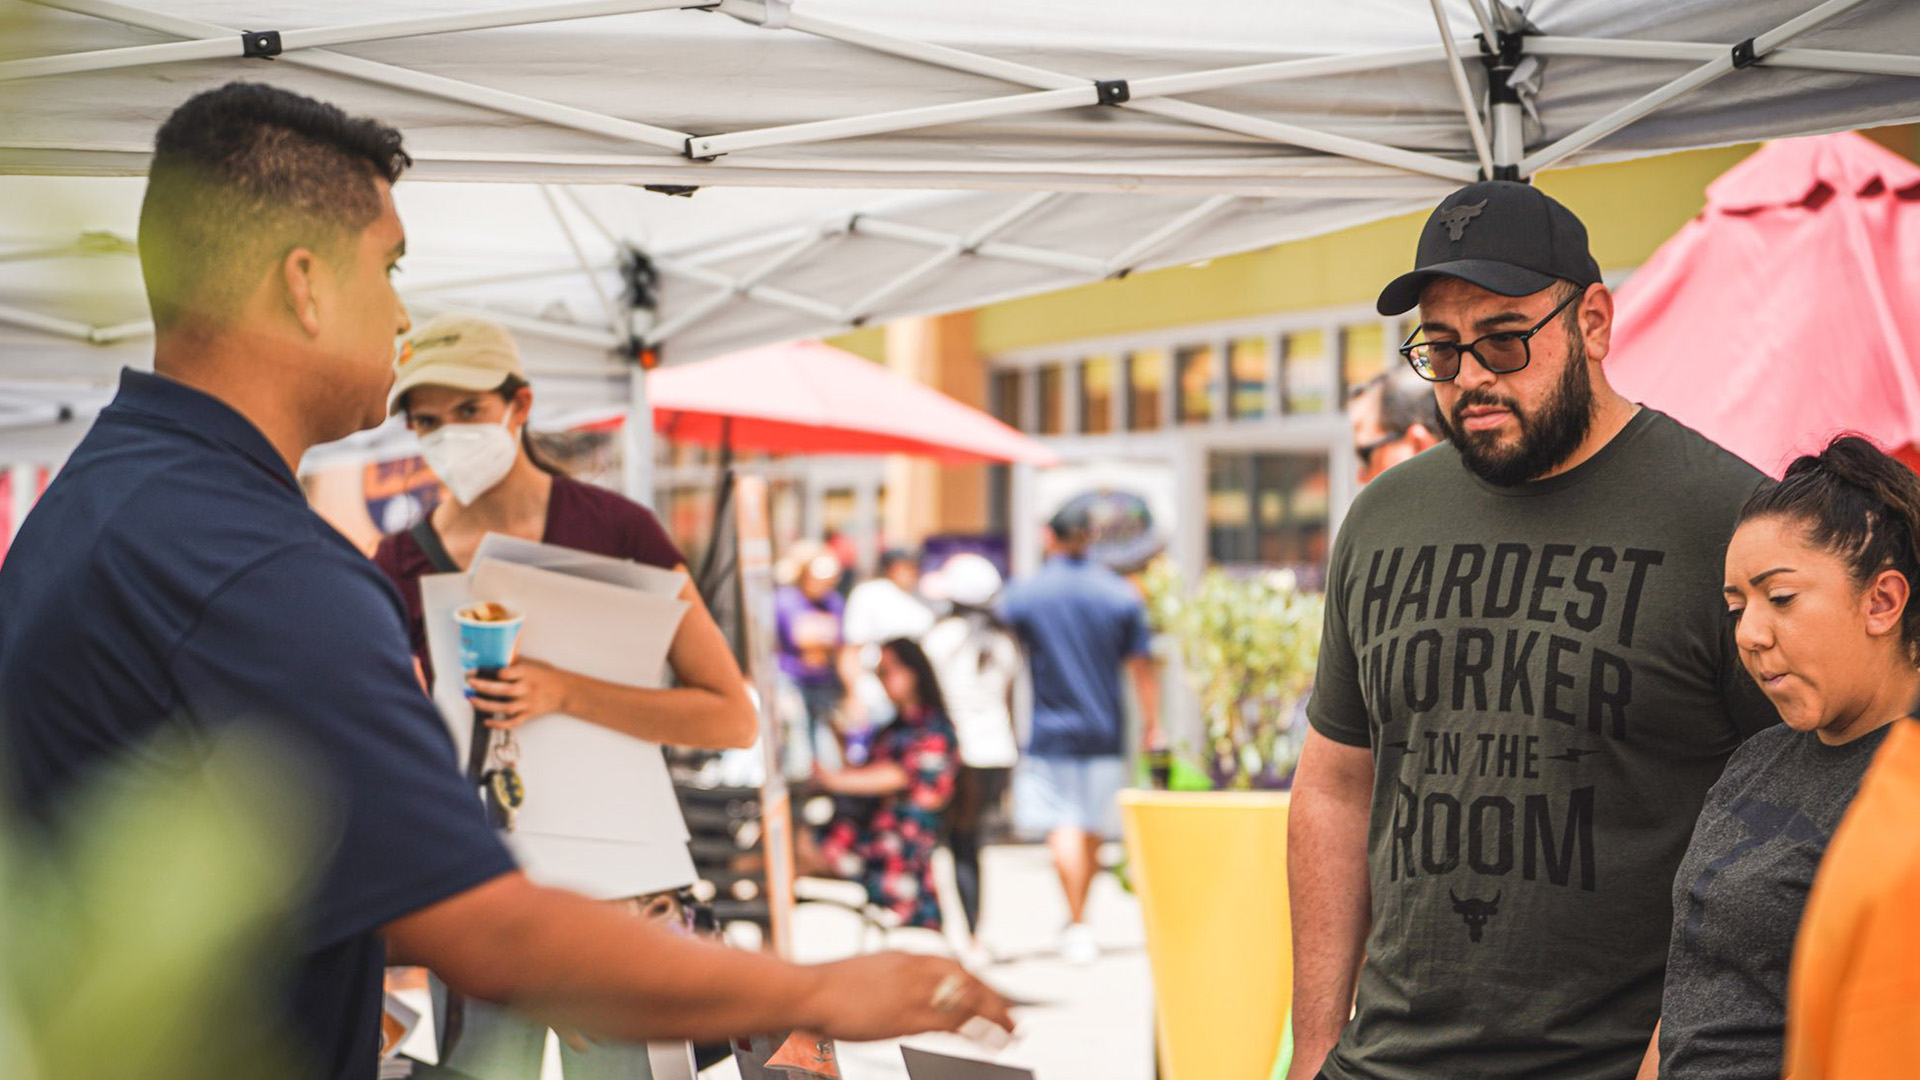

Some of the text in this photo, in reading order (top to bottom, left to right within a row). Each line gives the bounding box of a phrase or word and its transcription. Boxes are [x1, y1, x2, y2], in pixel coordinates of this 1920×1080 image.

[1361, 542, 1665, 648] HARDEST
[1361, 627, 1633, 741] WORKER
[1424, 730, 1540, 779] IN THE
[1390, 779, 1596, 892] ROOM
